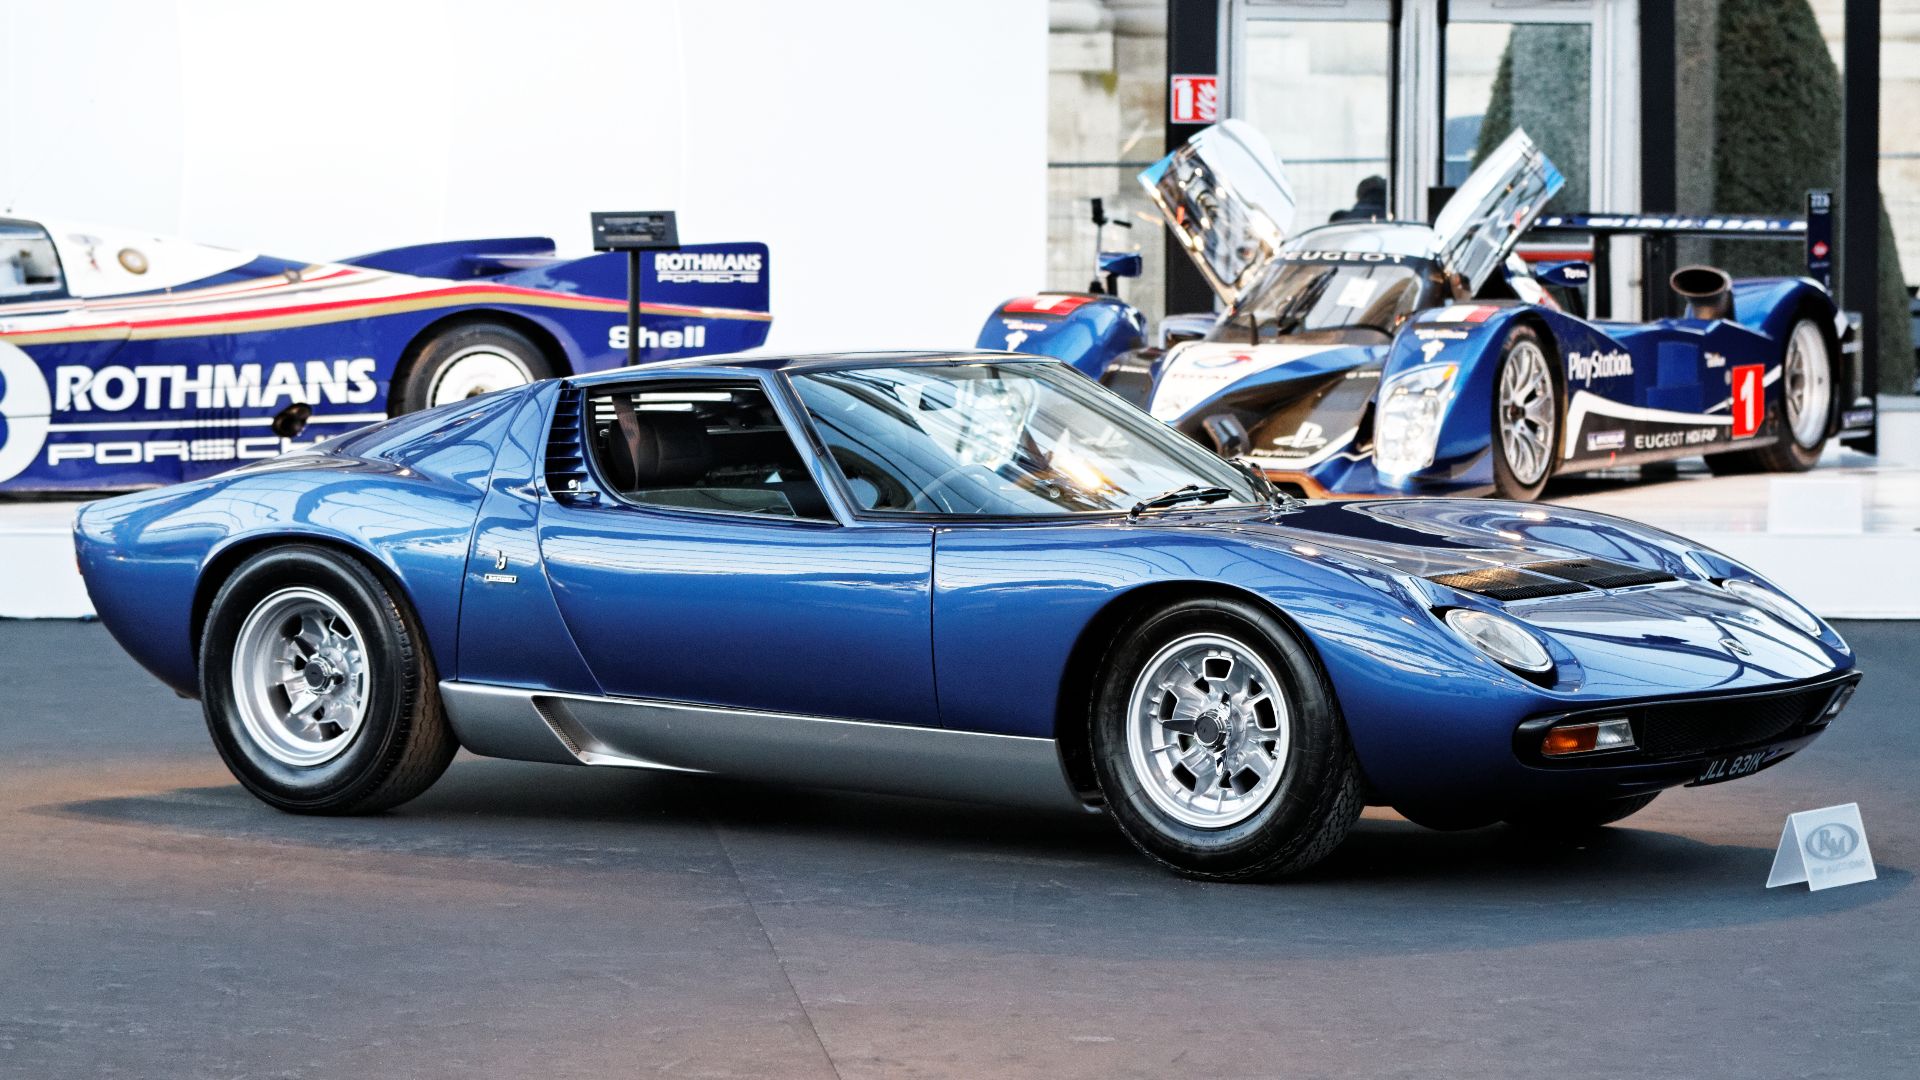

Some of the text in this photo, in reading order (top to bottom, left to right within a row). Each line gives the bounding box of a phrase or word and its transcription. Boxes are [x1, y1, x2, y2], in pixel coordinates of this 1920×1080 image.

[655, 253, 762, 271] ROTHMANS
[608, 325, 706, 349] Shell
[55, 359, 378, 412] ROTHMANS
[1740, 370, 1755, 431] 1
[48, 434, 337, 466] PORSCH
[1700, 752, 1766, 781] JLL 831K
